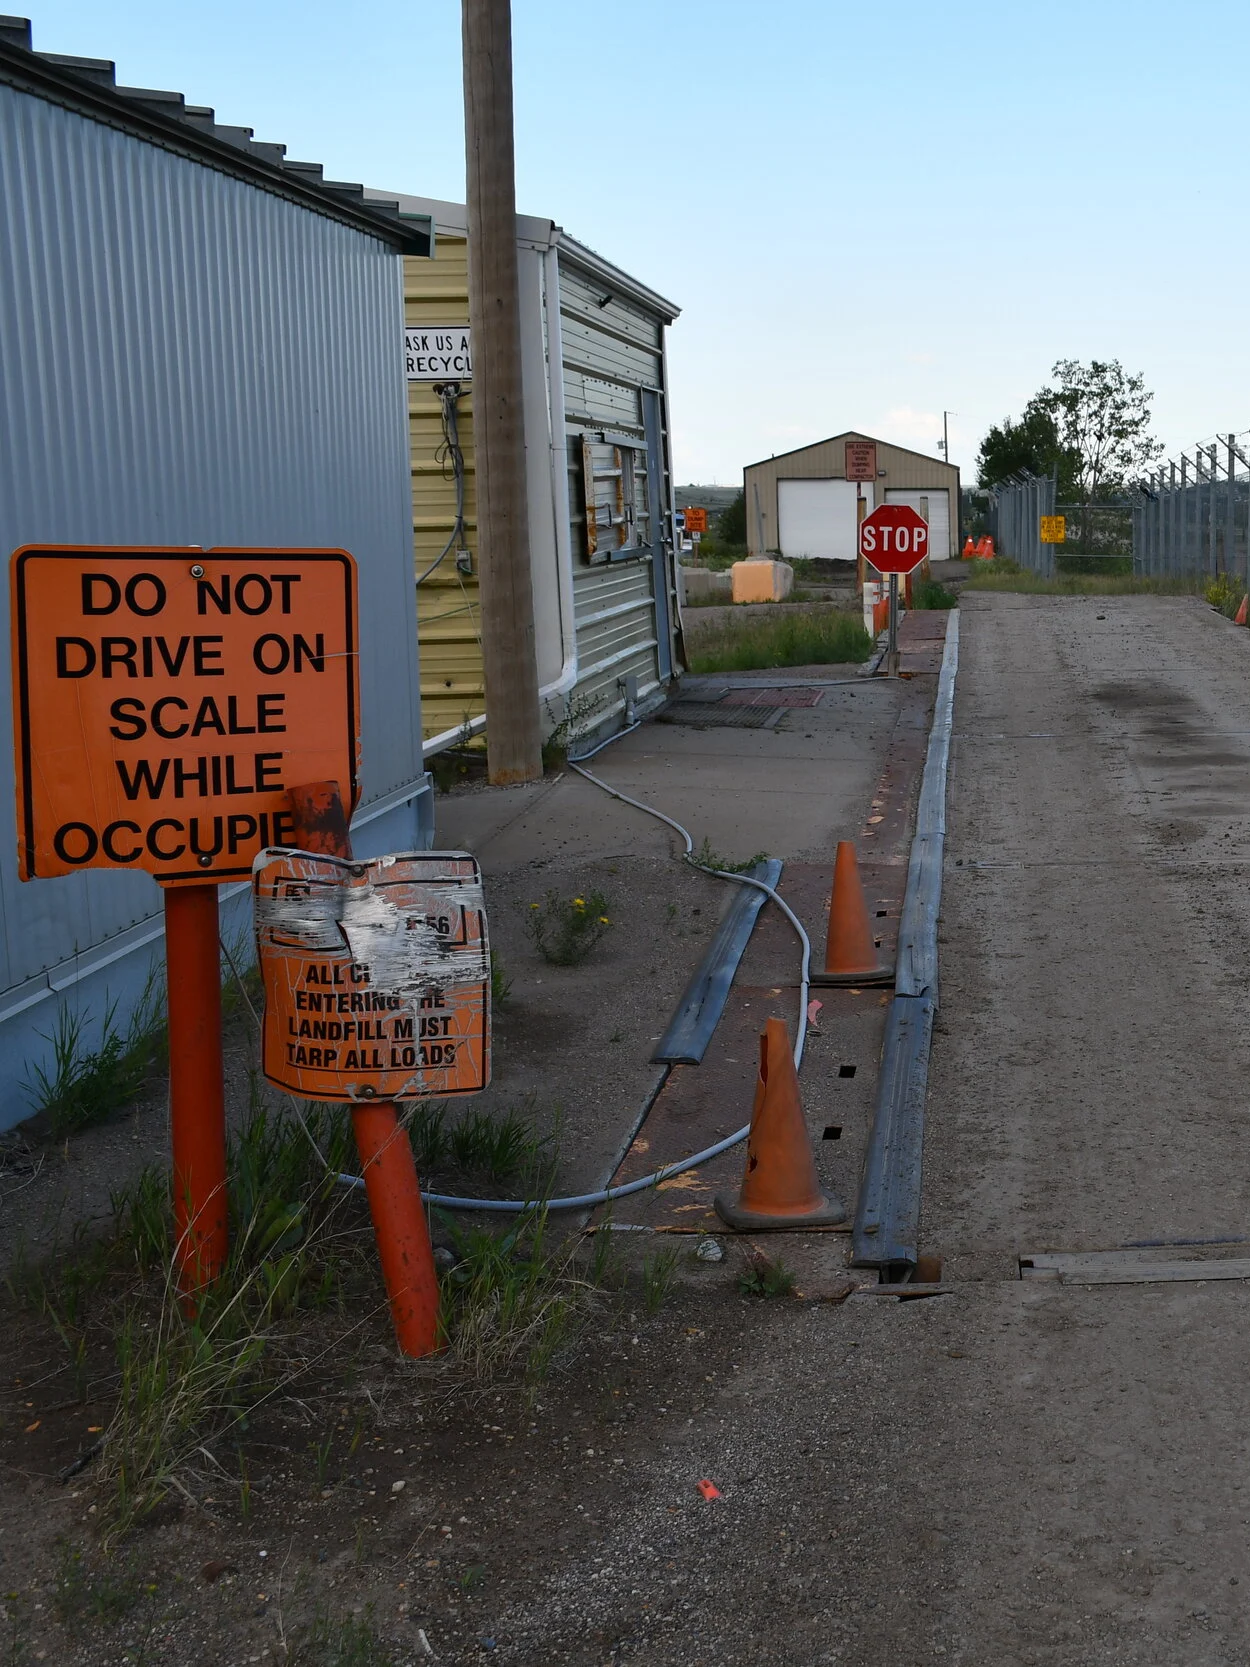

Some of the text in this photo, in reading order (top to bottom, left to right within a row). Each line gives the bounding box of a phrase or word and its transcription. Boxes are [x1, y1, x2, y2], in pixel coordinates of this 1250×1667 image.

[406, 335, 430, 352] ASK
[435, 335, 453, 352] US
[406, 355, 473, 373] RECYCL
[862, 525, 927, 552] STOP
[81, 572, 302, 617] DO NOT
[55, 632, 326, 679] DRIVE ON
[108, 693, 288, 741] SCALE
[115, 752, 286, 801] WHILE
[53, 810, 298, 865] OCCUPIE
[306, 964, 345, 985] ALL
[296, 987, 446, 1014] ENTERING HE
[288, 1016, 387, 1041] LANDFILL
[287, 1042, 456, 1069] TARP ALL LOADS
